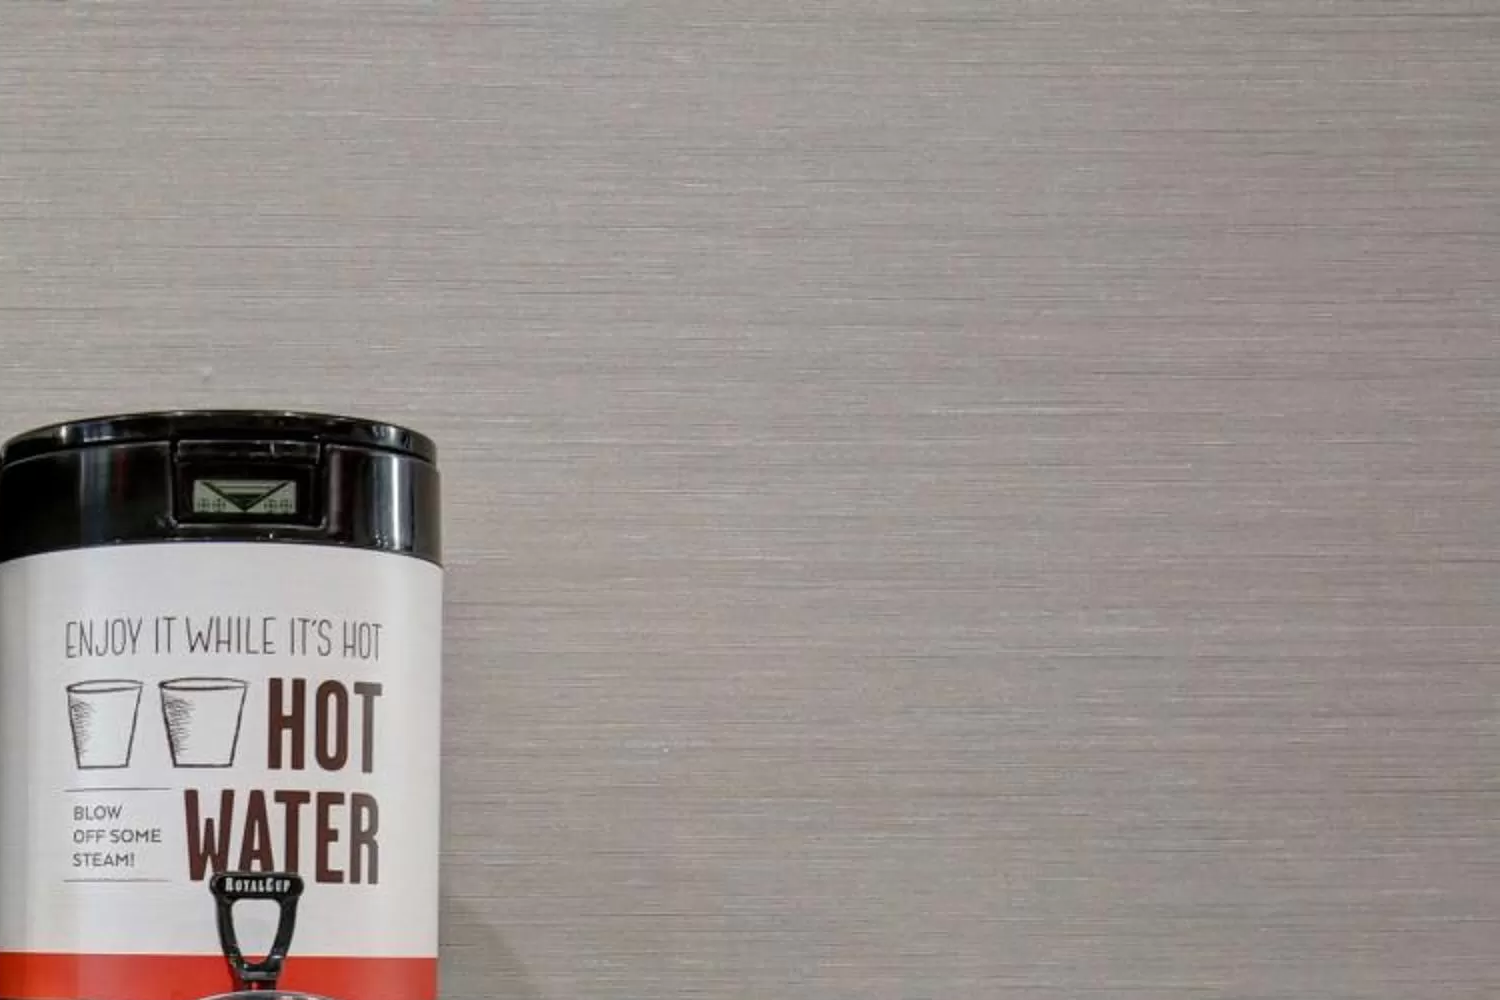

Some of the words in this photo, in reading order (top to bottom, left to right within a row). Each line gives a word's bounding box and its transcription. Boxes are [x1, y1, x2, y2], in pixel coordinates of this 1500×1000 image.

[65, 615, 143, 659] ENJOY
[154, 615, 177, 654] IT
[185, 615, 277, 655] WHILE
[289, 616, 332, 656] IT'S
[342, 620, 383, 661] HOT
[267, 677, 383, 774] HOT
[73, 805, 123, 821] BLOW
[73, 830, 105, 844] OFF
[109, 829, 162, 844] SOME
[184, 788, 380, 885] WATER
[73, 853, 135, 868] STEAM!
